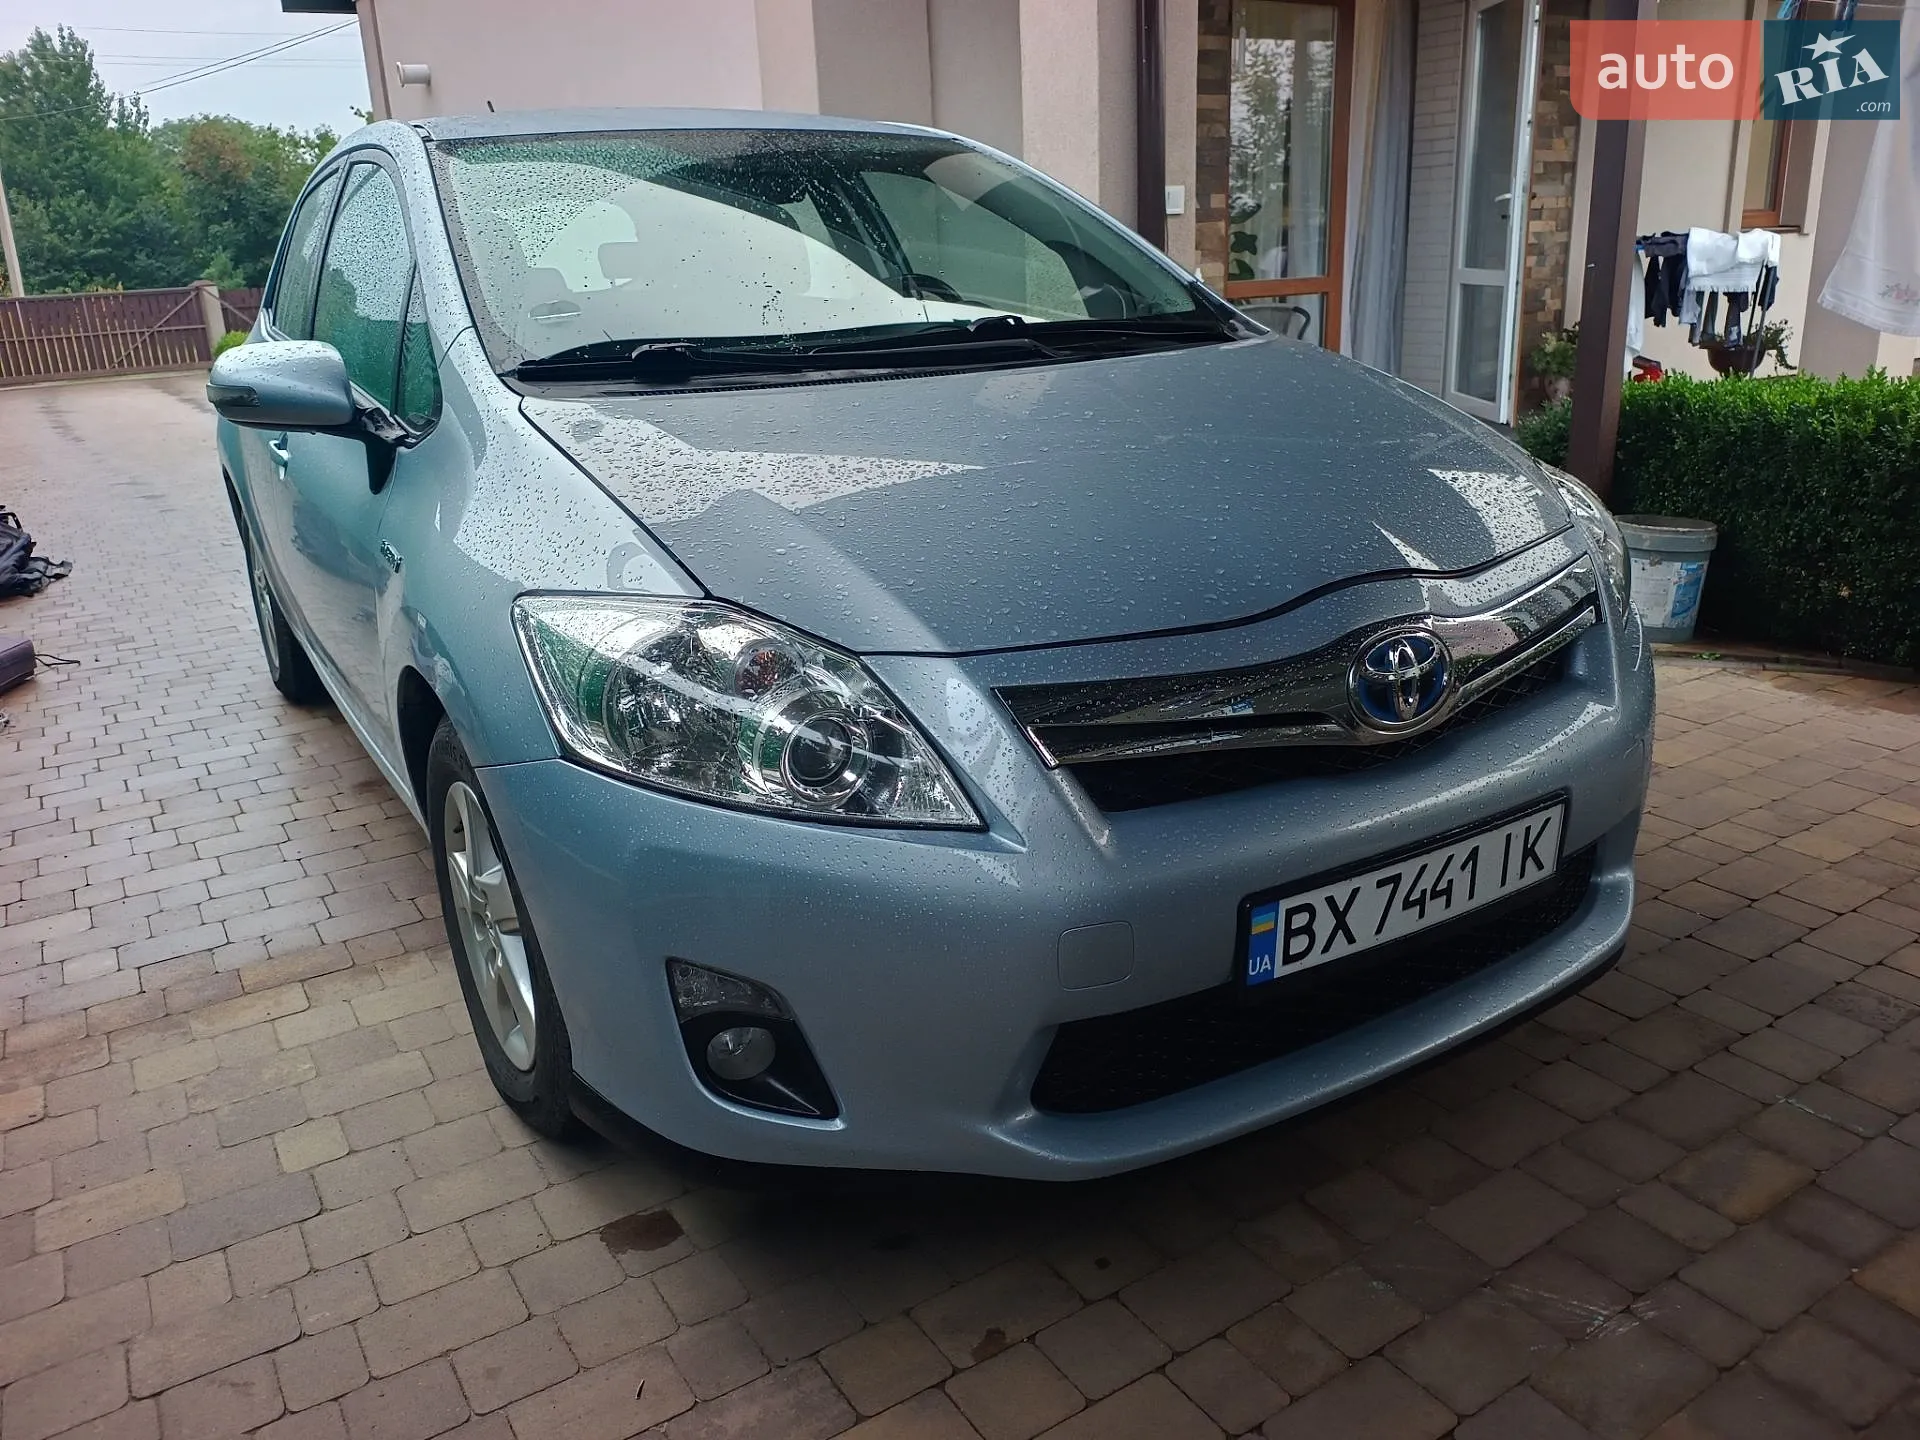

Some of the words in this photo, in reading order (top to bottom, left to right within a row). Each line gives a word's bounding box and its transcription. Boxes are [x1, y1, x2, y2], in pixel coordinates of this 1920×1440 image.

[1282, 886, 1361, 967] BX
[1374, 844, 1481, 936] 7441
[1500, 816, 1552, 889] IK
[1248, 954, 1272, 976] UA
